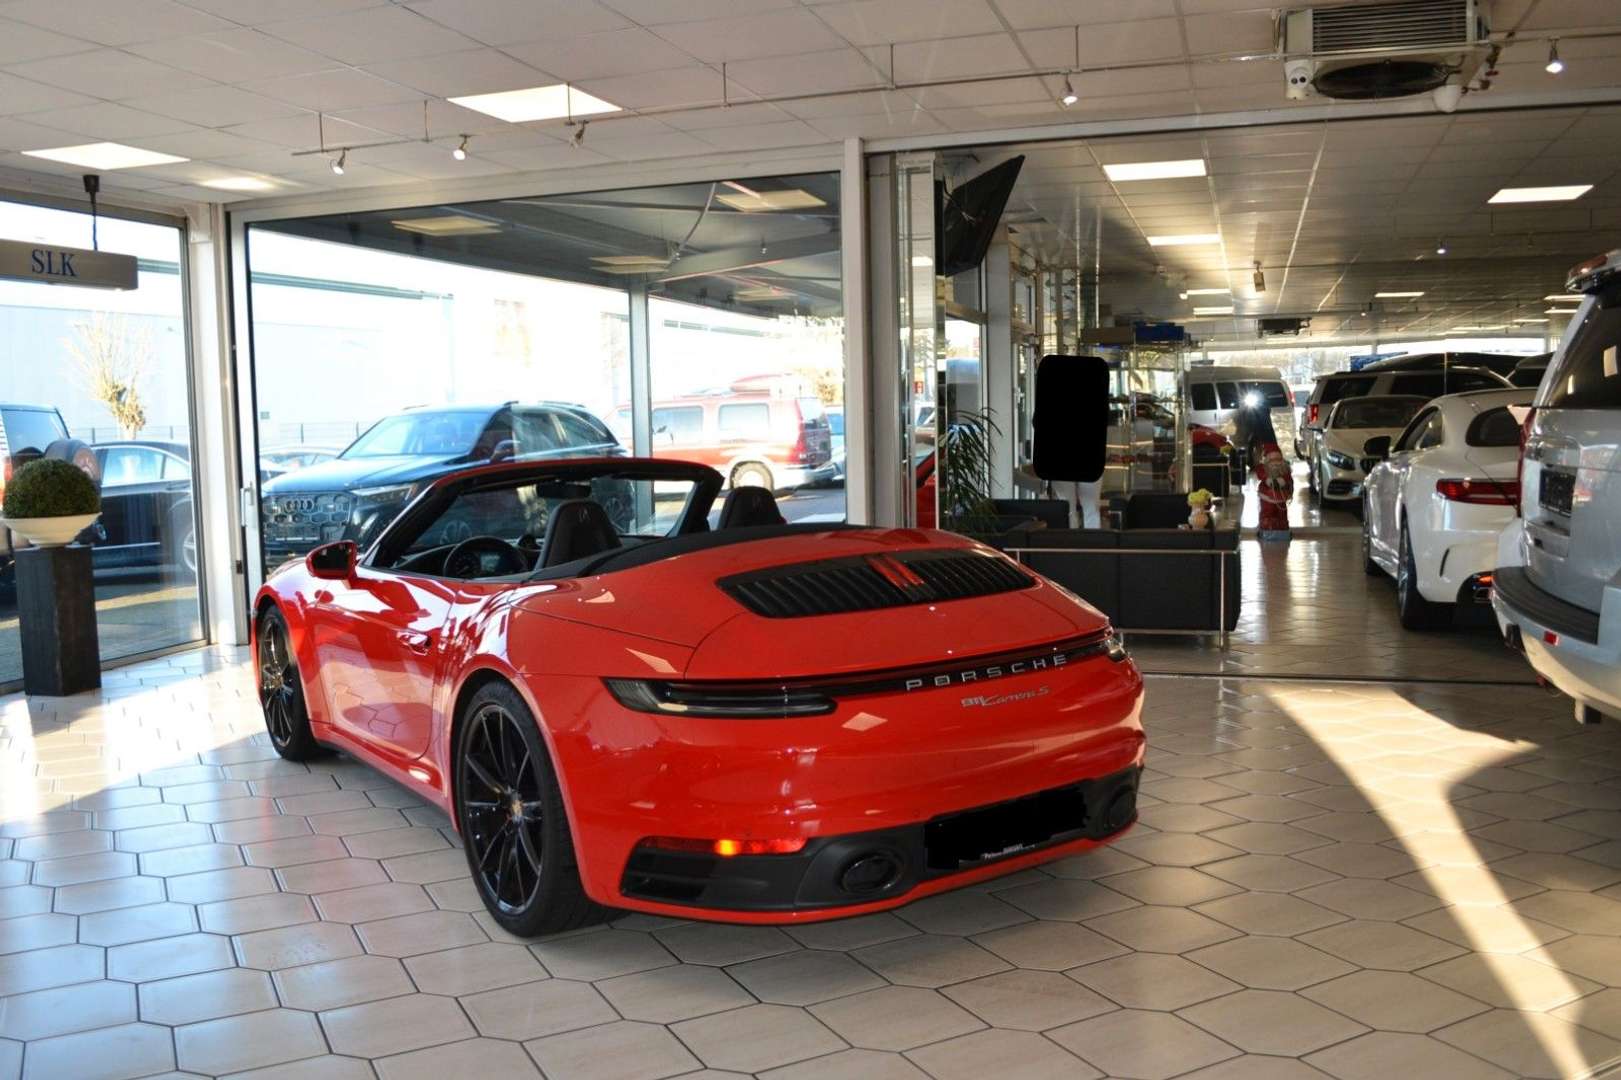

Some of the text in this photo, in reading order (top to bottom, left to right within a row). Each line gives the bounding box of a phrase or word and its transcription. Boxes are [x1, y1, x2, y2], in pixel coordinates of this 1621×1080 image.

[31, 249, 76, 276] SLK
[905, 654, 1067, 691] PORSCHE
[1038, 685, 1050, 696] S
